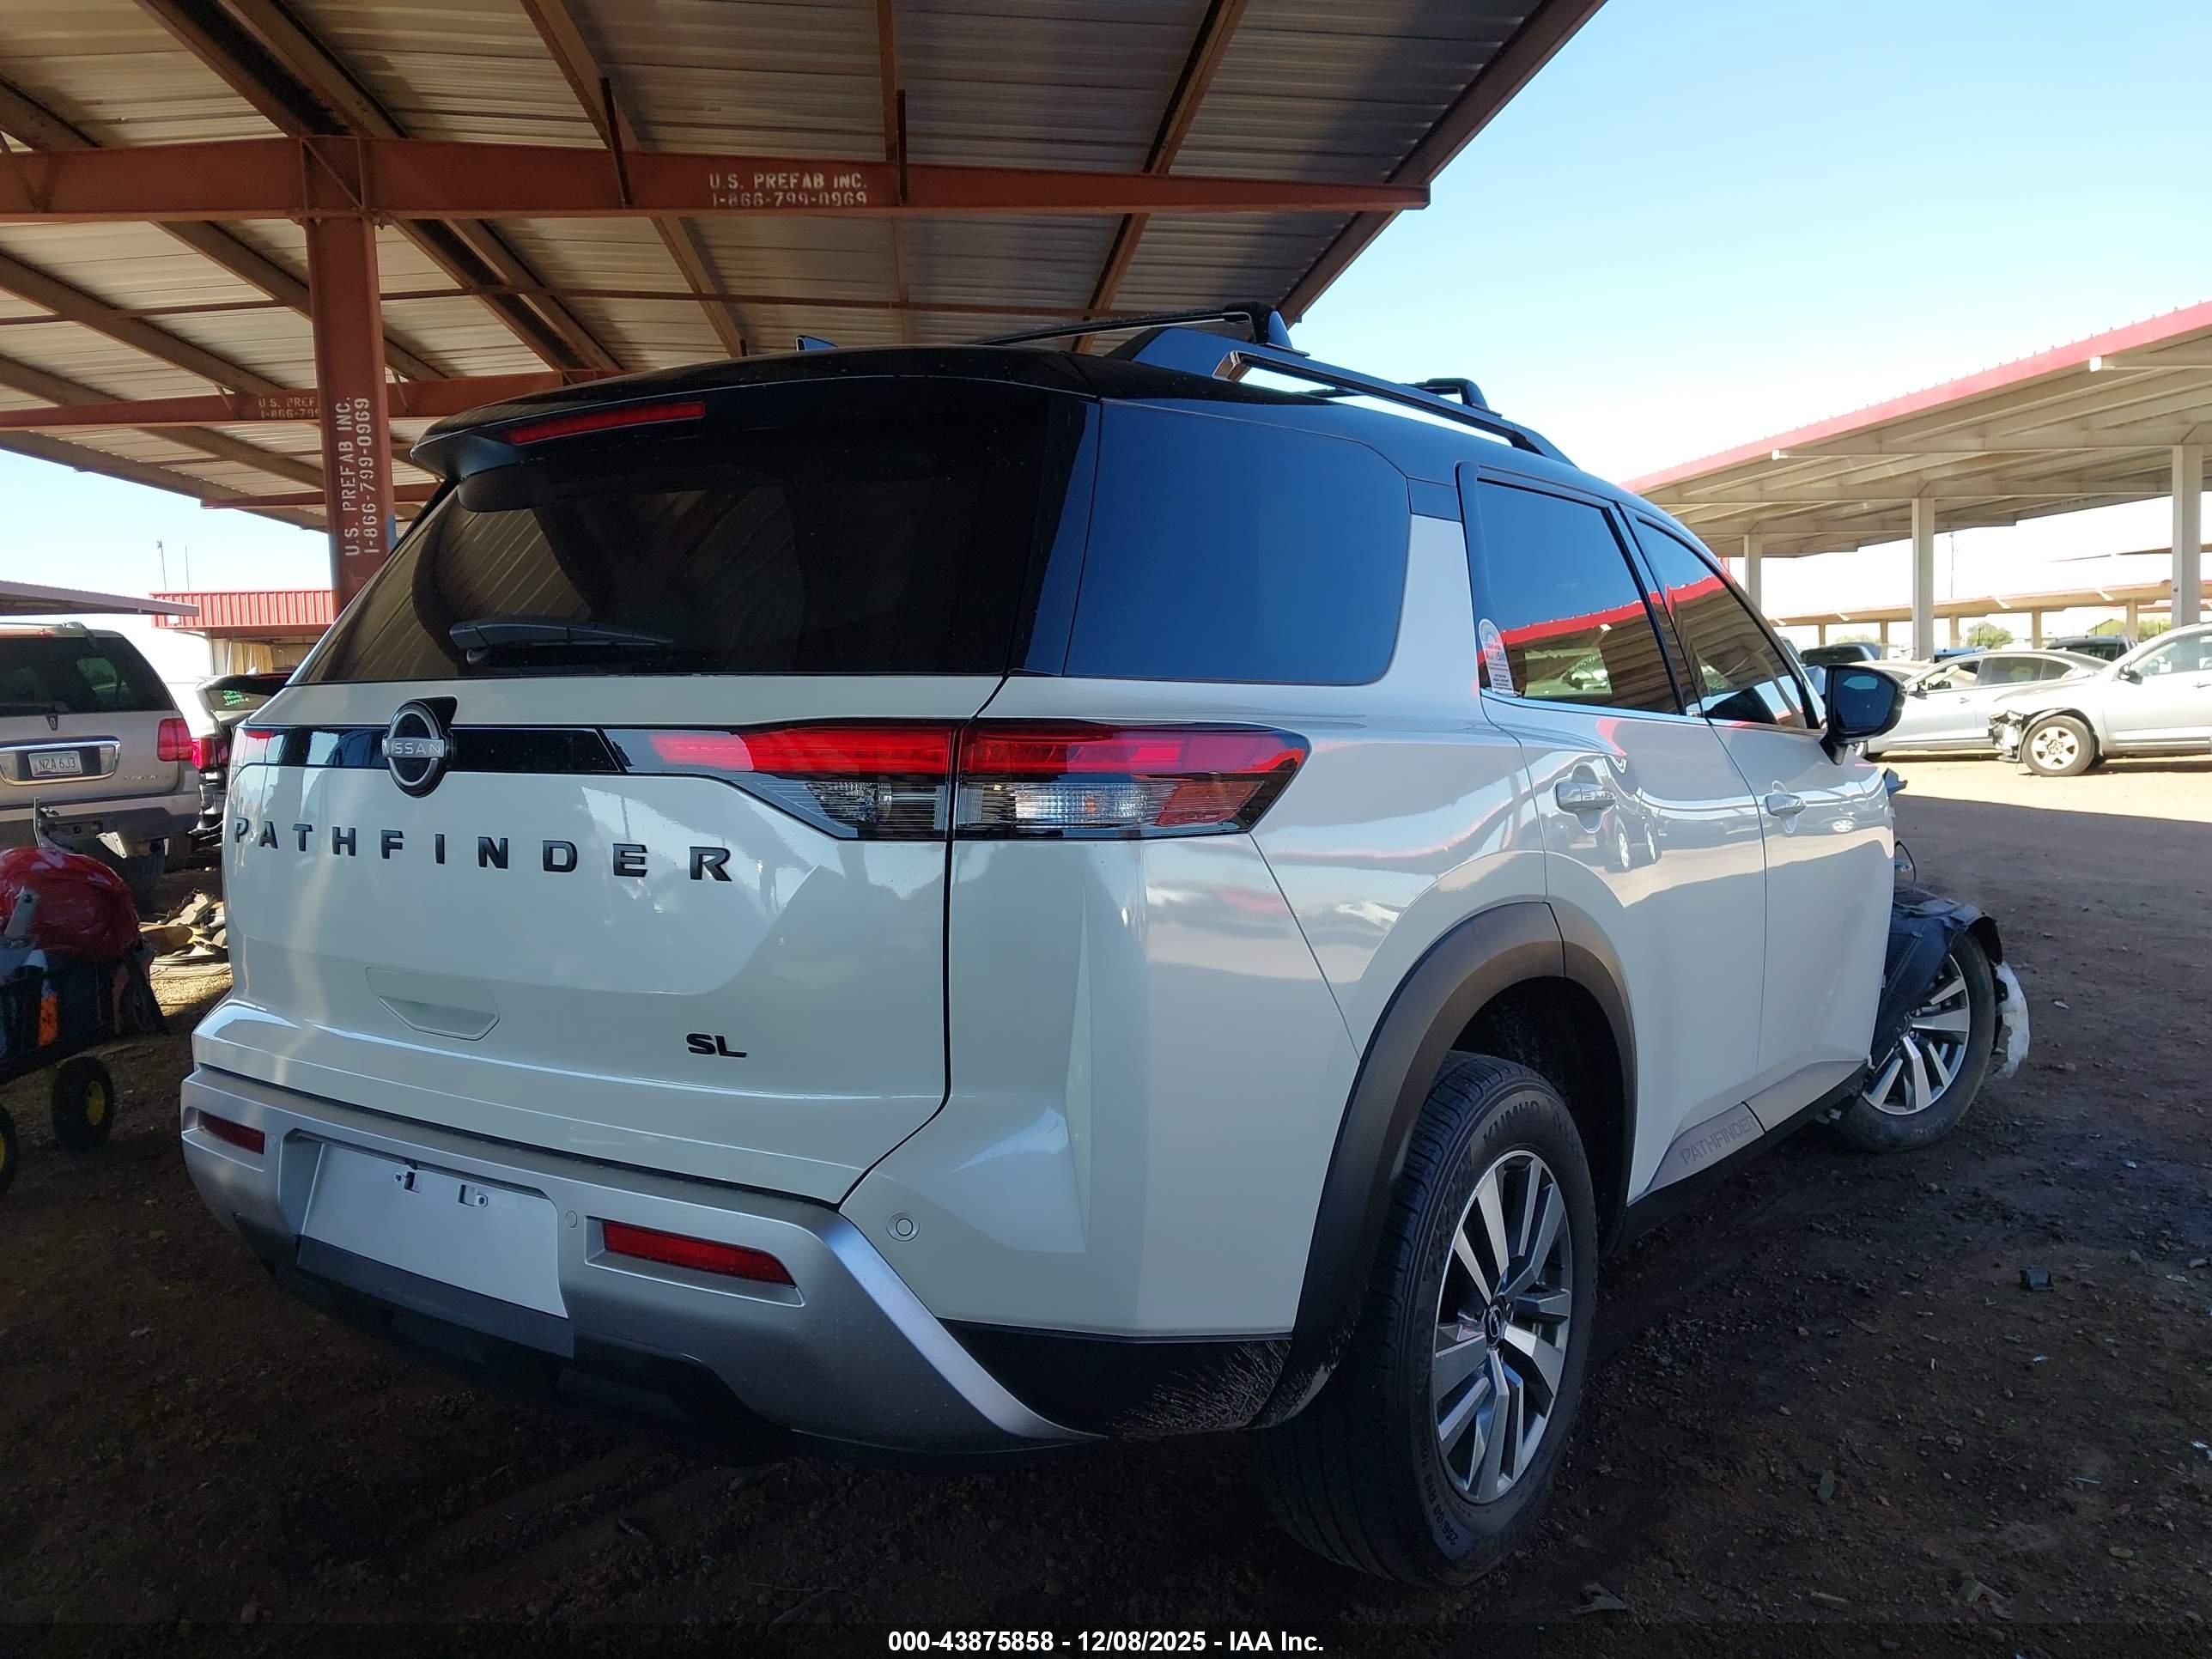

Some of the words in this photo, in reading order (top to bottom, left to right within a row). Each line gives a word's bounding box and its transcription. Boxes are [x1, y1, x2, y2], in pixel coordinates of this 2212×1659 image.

[709, 173, 744, 189] U.S.
[754, 173, 824, 189] PREFAB
[833, 173, 867, 189] INC.
[335, 396, 352, 432] INC.
[337, 441, 357, 511] PREFAB
[354, 398, 380, 554] 1-866-799-0969
[344, 521, 361, 556] U.S.
[234, 816, 733, 883] PATHFINDER
[686, 1033, 747, 1058] SL
[1680, 1116, 1758, 1166] PATHFINDER
